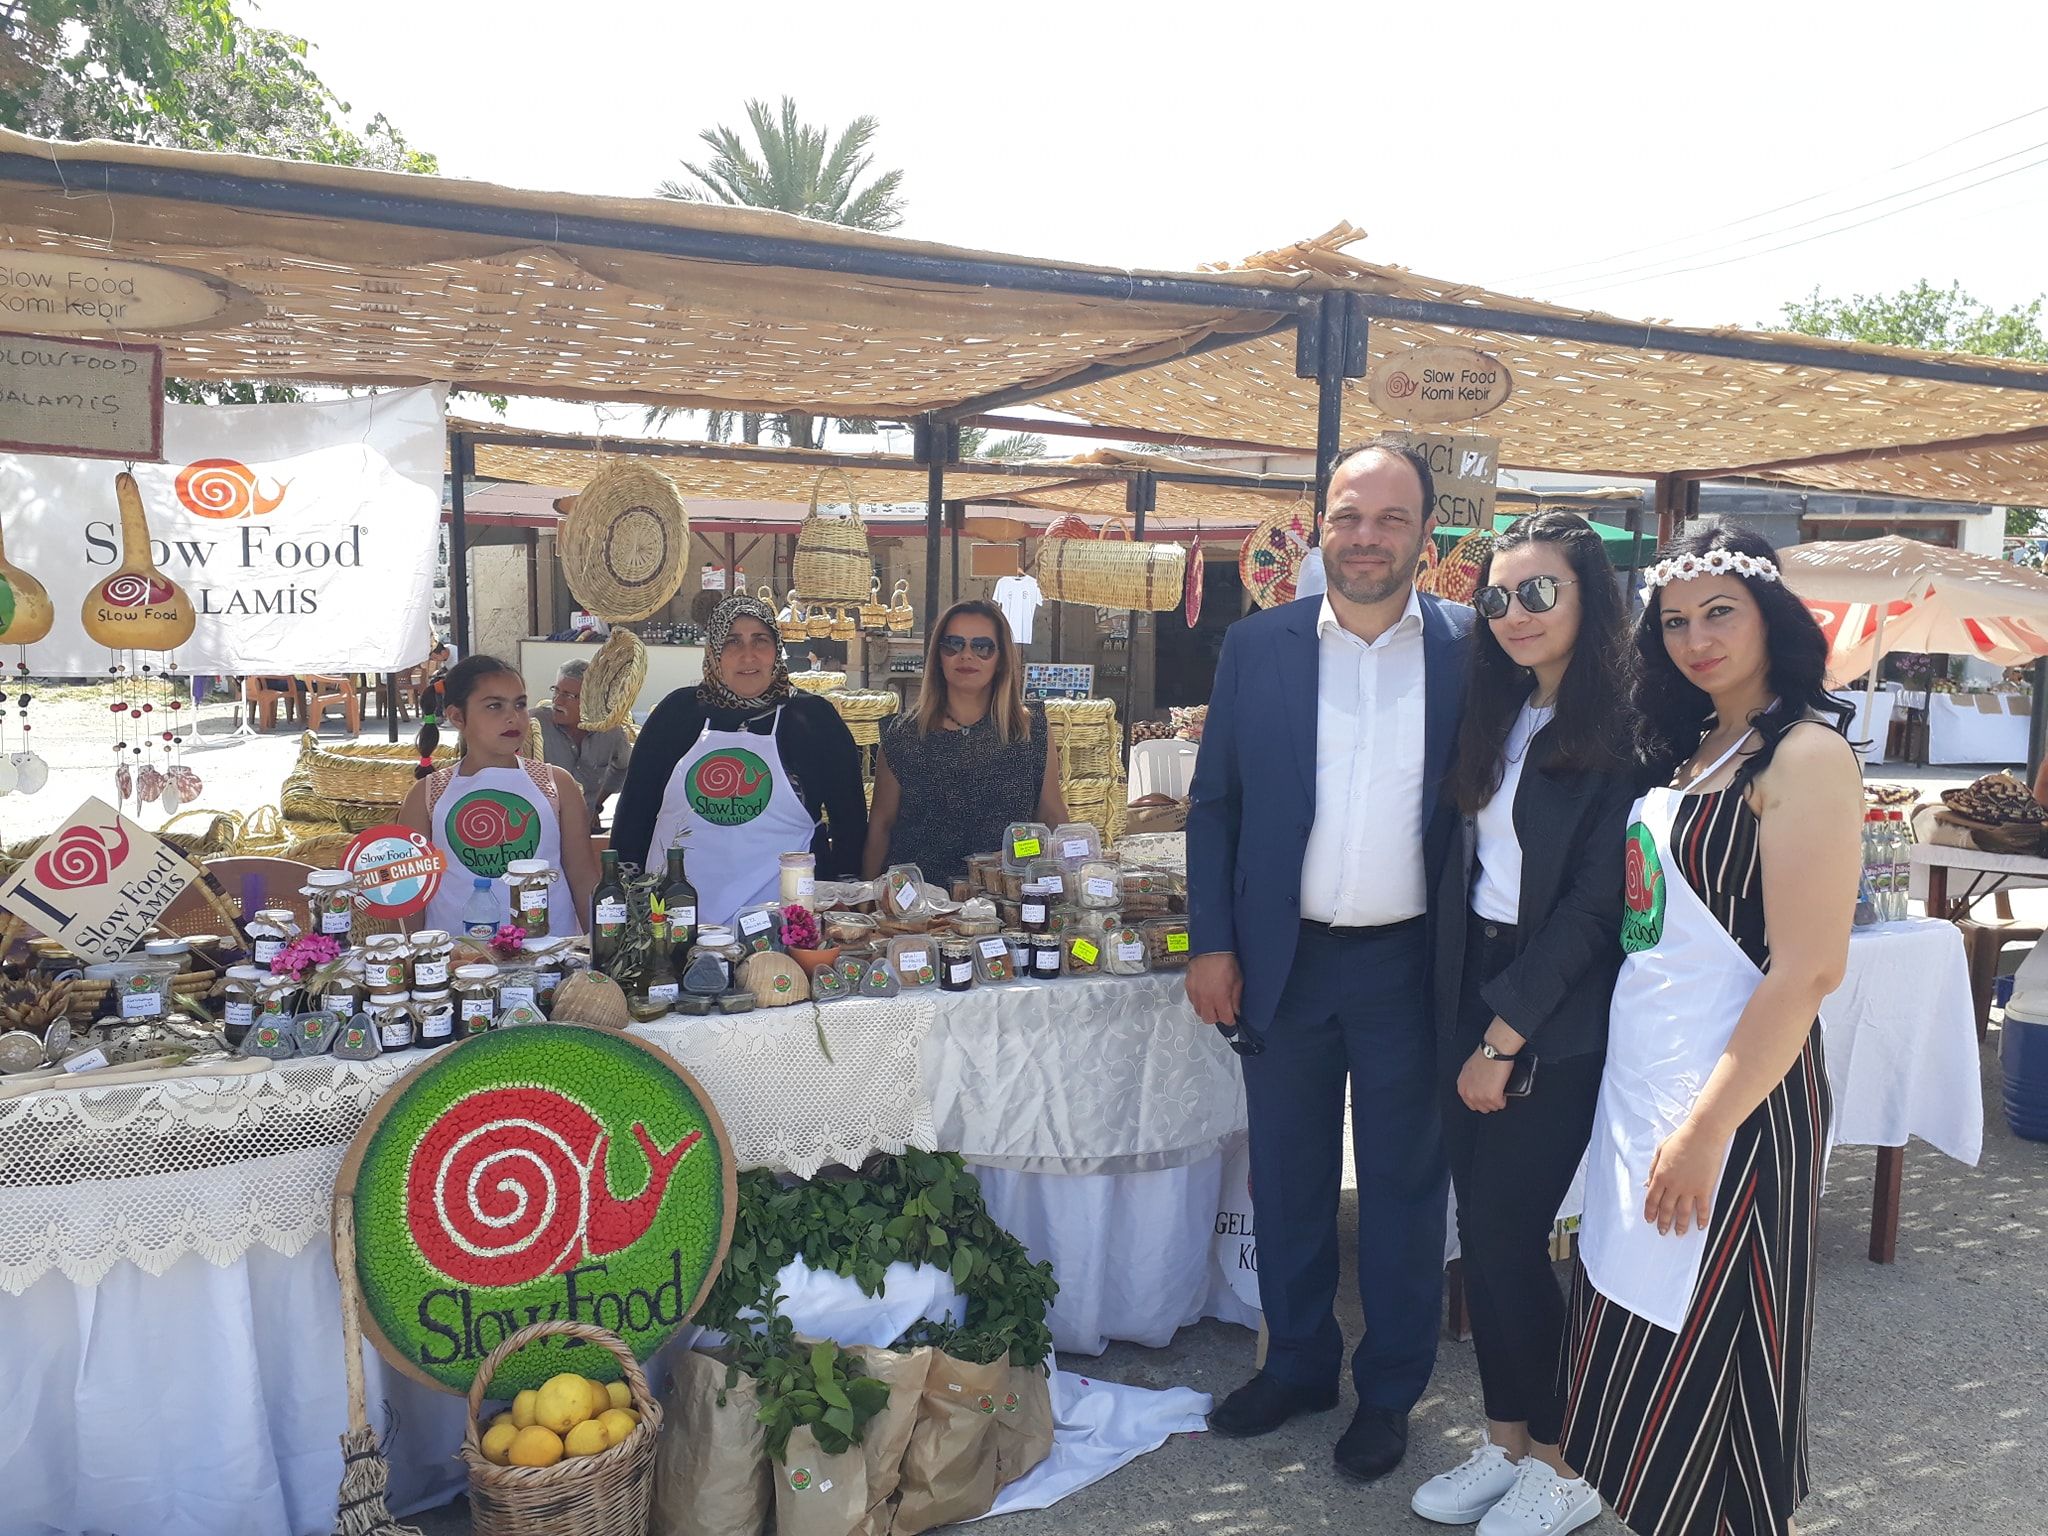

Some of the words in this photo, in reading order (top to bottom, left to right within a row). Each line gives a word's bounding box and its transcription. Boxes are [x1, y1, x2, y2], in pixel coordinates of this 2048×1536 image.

[68, 271, 134, 295] Food
[65, 297, 127, 318] Kebir
[1423, 368, 1455, 384] Slow
[1461, 369, 1497, 384] Food
[1421, 386, 1455, 400] Komi
[1458, 386, 1492, 401] Kebir
[84, 521, 218, 569] Sow
[144, 608, 178, 620] Food
[696, 796, 730, 815] Slow
[730, 797, 763, 816] Food
[360, 852, 386, 864] Slow
[387, 848, 413, 861] Food
[462, 848, 499, 867] Slow
[497, 840, 534, 865] Food
[390, 857, 441, 879] CHANGE
[6, 878, 78, 933] I
[75, 902, 129, 954] Slow
[118, 850, 178, 908] Food
[1214, 1211, 1256, 1237] GEL
[418, 1288, 559, 1365] Slow
[565, 1249, 683, 1349] Food
